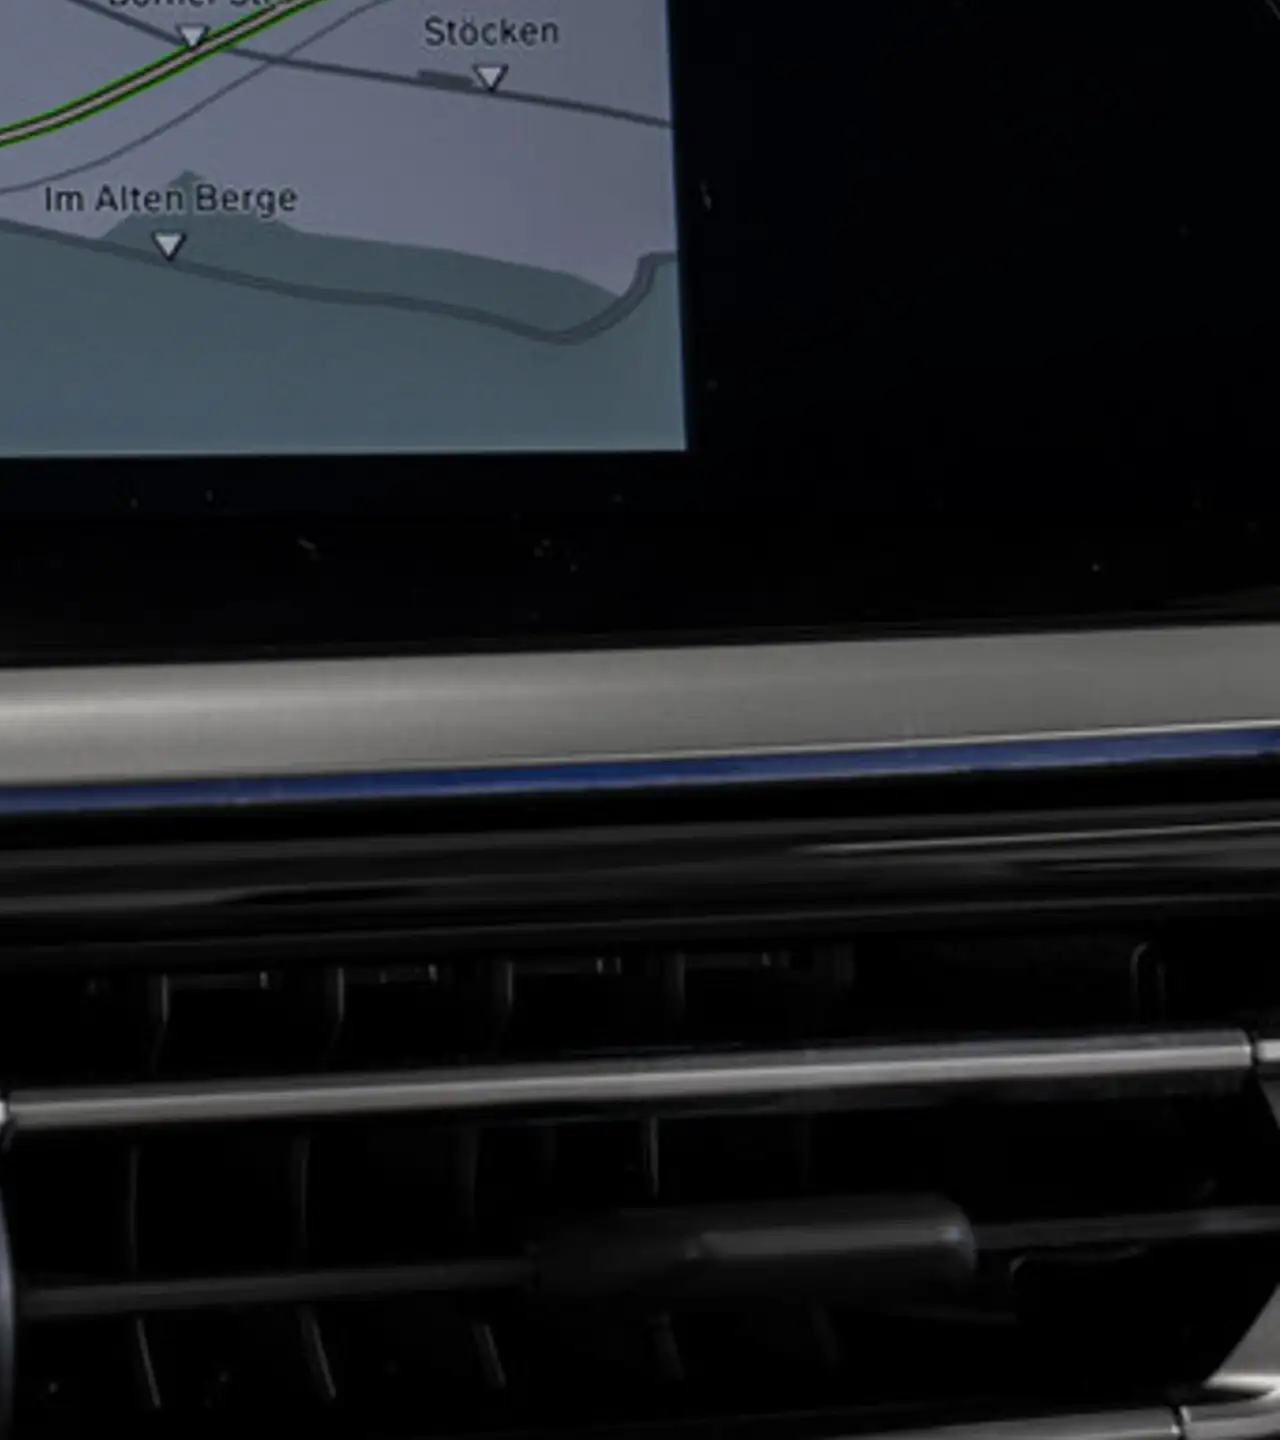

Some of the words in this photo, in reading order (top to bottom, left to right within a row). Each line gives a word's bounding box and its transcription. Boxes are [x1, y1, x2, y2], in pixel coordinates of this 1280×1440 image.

[424, 12, 560, 46] Stöcken
[44, 184, 85, 212] Im
[95, 180, 184, 212] Alten
[195, 180, 298, 220] Berge
